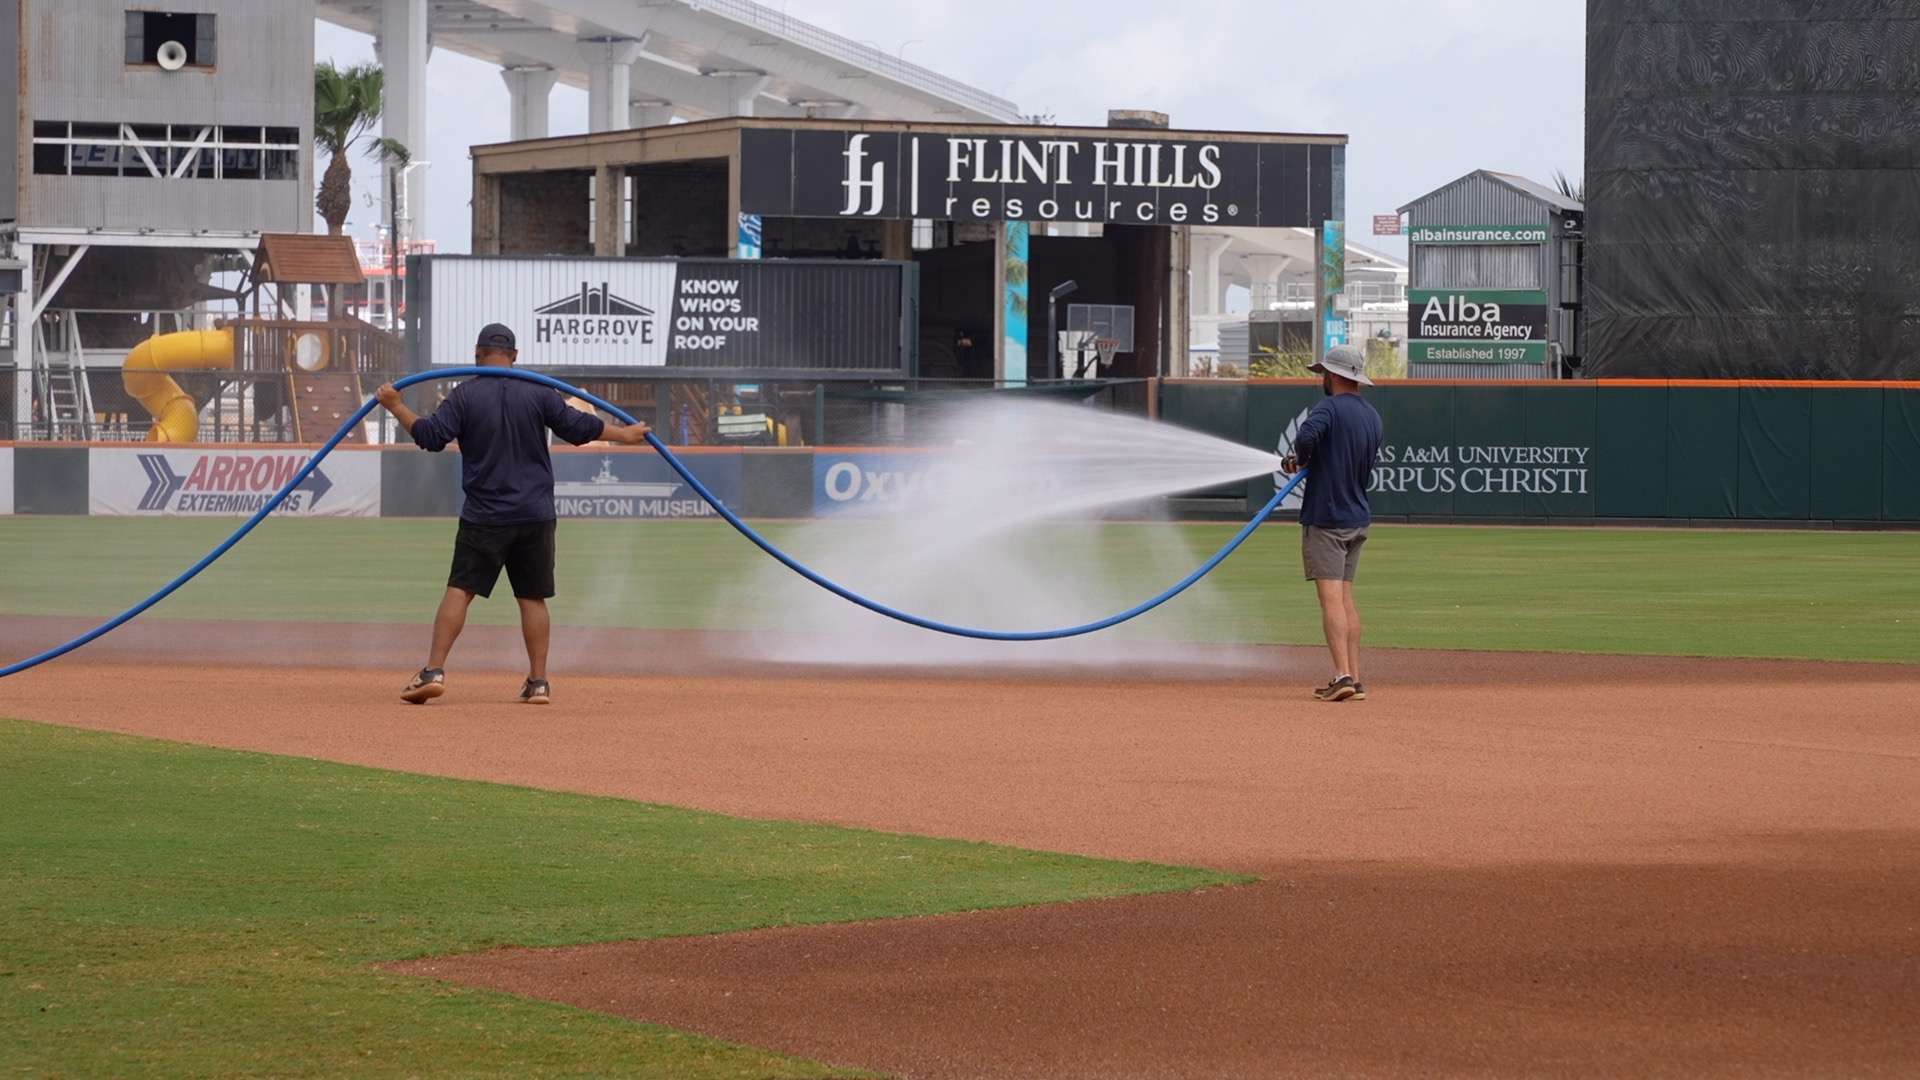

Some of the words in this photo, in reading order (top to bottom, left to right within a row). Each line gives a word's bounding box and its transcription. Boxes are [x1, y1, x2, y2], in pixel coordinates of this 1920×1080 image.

[946, 138, 1079, 184] FLINT
[1092, 142, 1222, 189] HILLS
[1411, 228, 1546, 242] albainsurance.com
[681, 279, 739, 295] KNOW
[680, 298, 742, 313] WHO'S
[1421, 296, 1500, 322] Alba
[536, 318, 653, 344] HARGROVE
[676, 317, 704, 331] ON
[709, 317, 759, 332] YOUR
[1421, 321, 1481, 337] Insurance
[1484, 322, 1532, 340] Agency
[562, 337, 630, 346] ROOFING
[674, 335, 726, 350] ROOF
[1427, 347, 1493, 360] Established
[1498, 348, 1526, 360] 1997
[1402, 446, 1450, 463] A&M
[1458, 446, 1590, 465] UNIVERSITY
[183, 455, 306, 491] ARROW
[1366, 467, 1456, 493] RPUS
[1460, 467, 1588, 494] CHRISTI
[177, 493, 302, 512] EXTERMINATRS
[555, 499, 633, 517] INGTON
